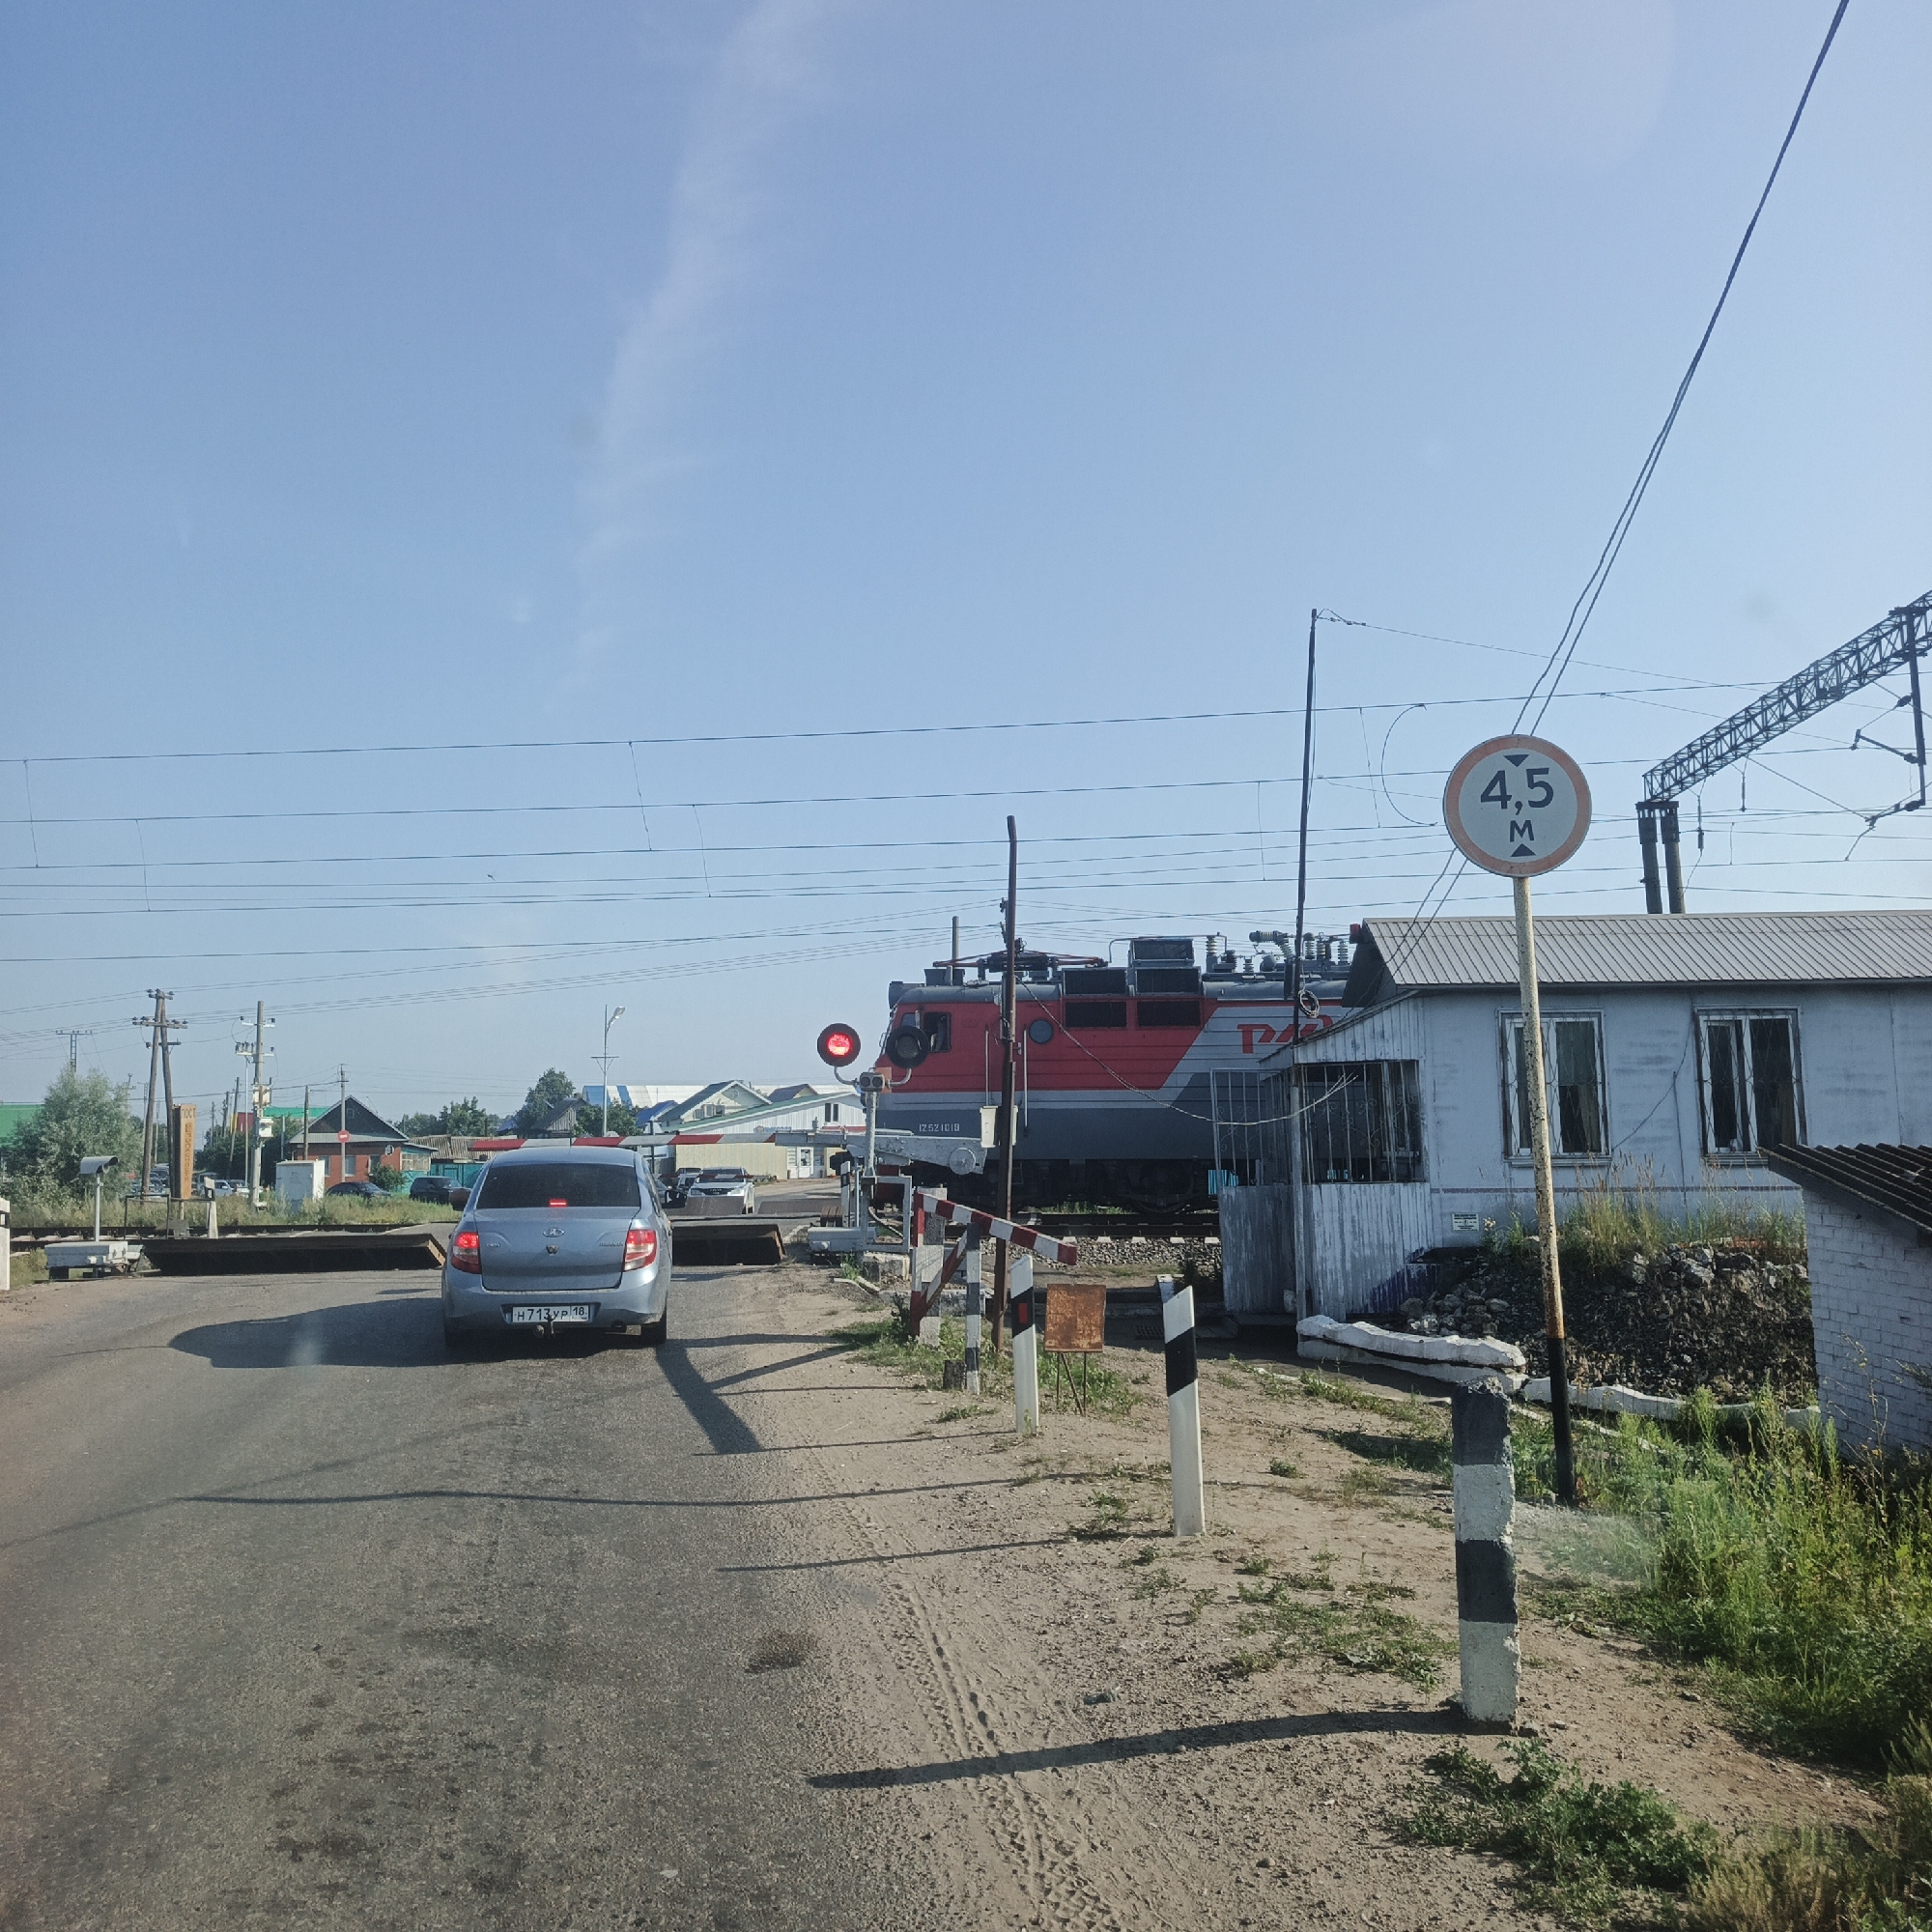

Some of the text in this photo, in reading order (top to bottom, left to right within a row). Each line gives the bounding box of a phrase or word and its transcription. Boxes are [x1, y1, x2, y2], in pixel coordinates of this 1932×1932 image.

[1480, 767, 1554, 815] 4,5
[181, 1107, 196, 1120] ПОСТ
[572, 1306, 585, 1317] 18
